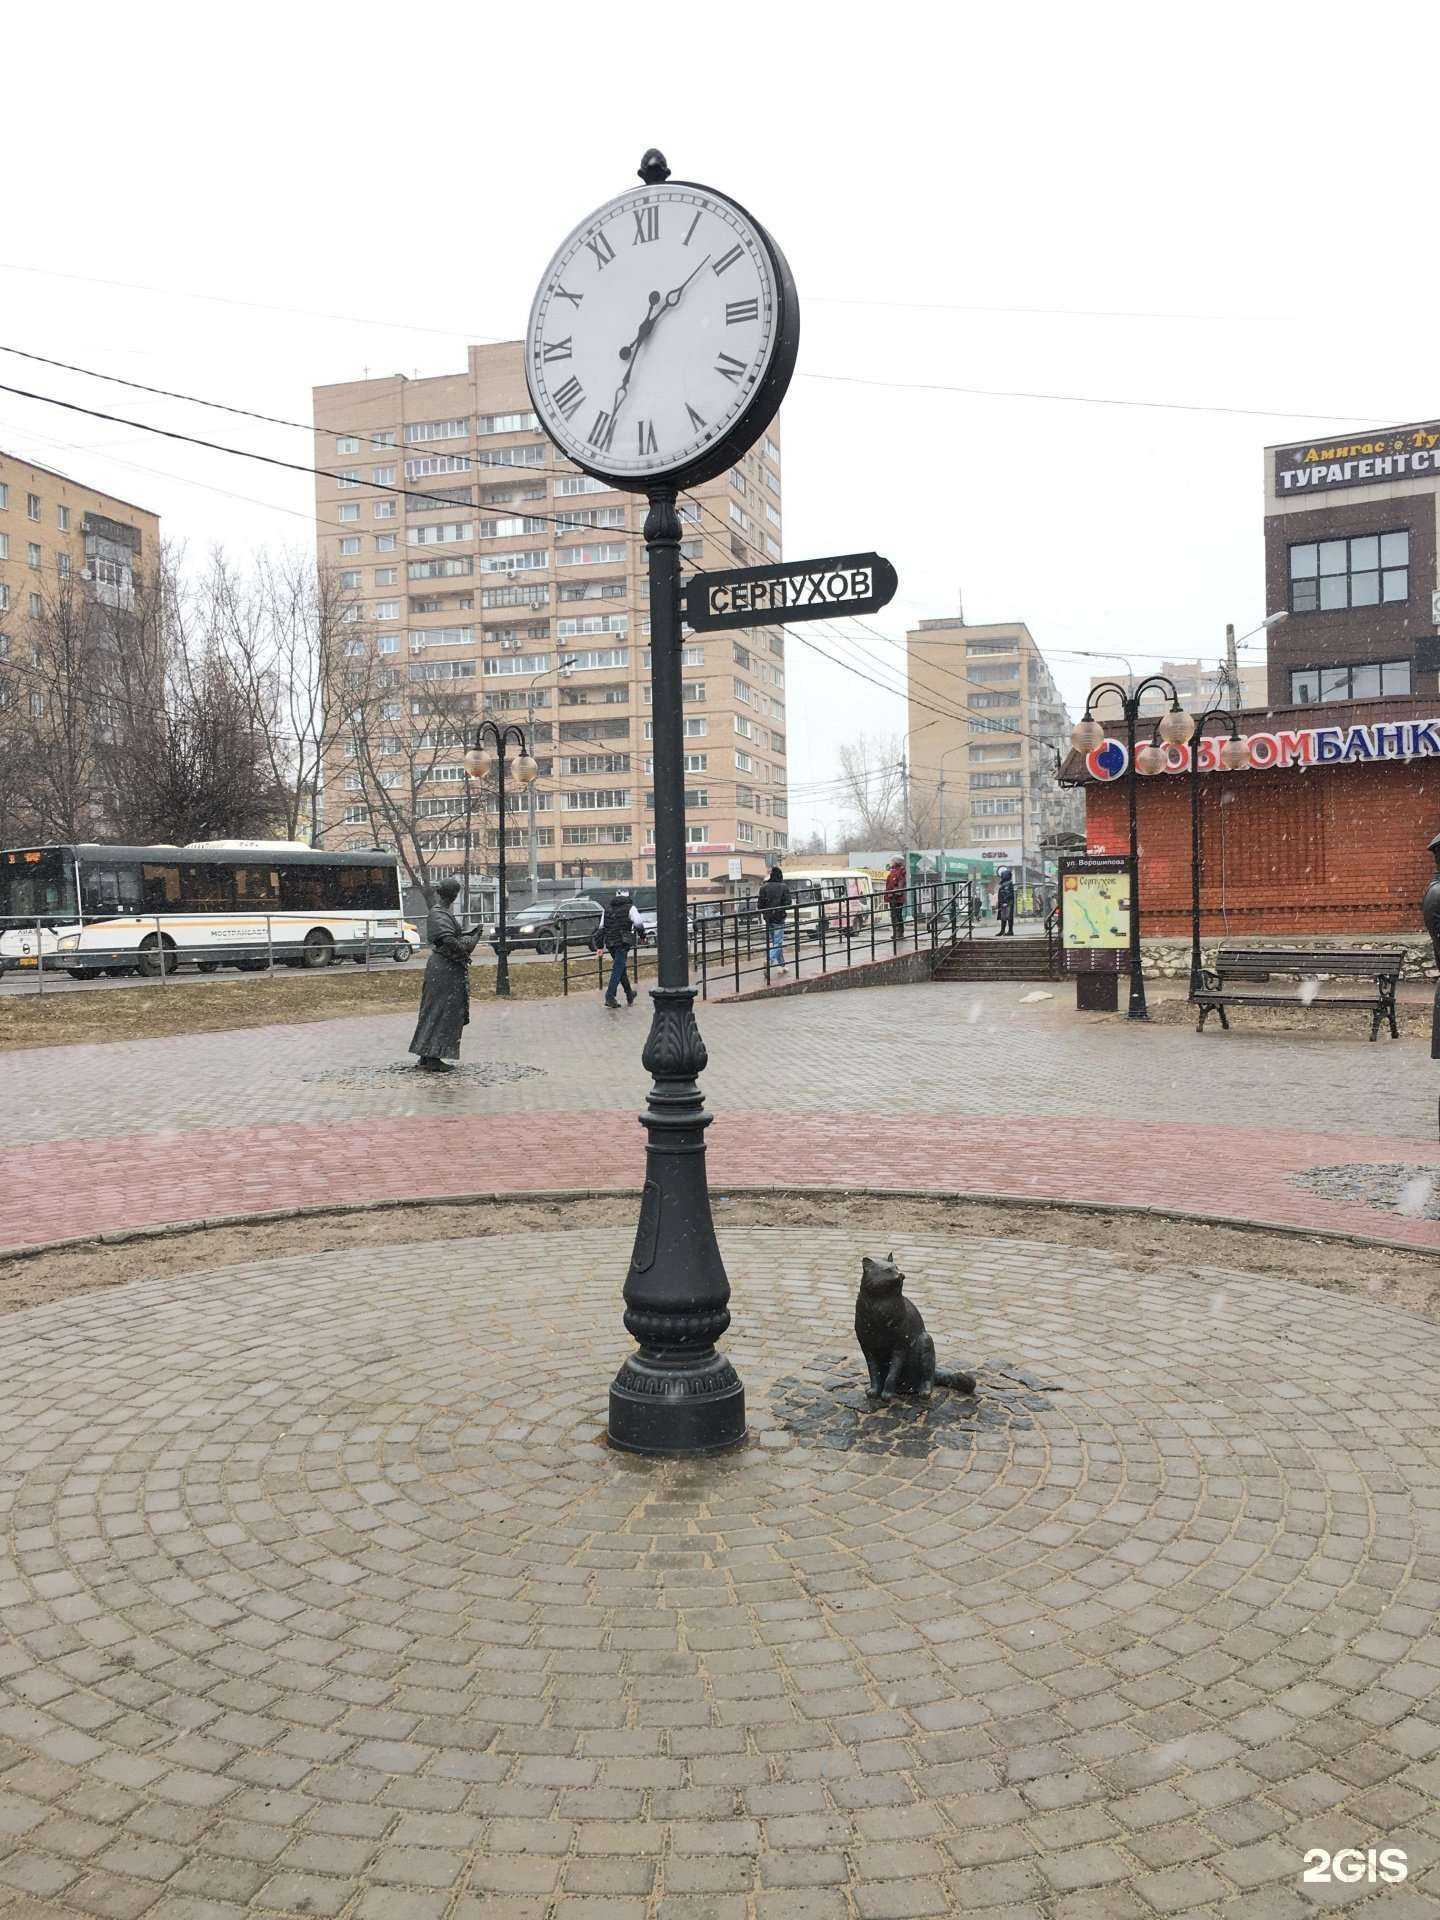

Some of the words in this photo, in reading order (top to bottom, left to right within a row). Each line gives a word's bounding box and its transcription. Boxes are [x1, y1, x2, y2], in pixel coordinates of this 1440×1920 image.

[632, 205, 660, 246] XII
[585, 230, 617, 271] XI
[712, 243, 746, 277] II
[554, 284, 584, 310] X
[725, 297, 759, 326] III
[543, 336, 573, 363] IX
[713, 352, 749, 384] IV
[552, 375, 587, 422] VIII
[685, 402, 708, 433] V
[637, 419, 659, 456] VI
[1304, 441, 1386, 463] Амигас
[710, 570, 872, 613] СЕРПУХОВ
[1079, 859, 1125, 867] Ворошилова
[210, 928, 271, 937] МОСТРАНСАВТ
